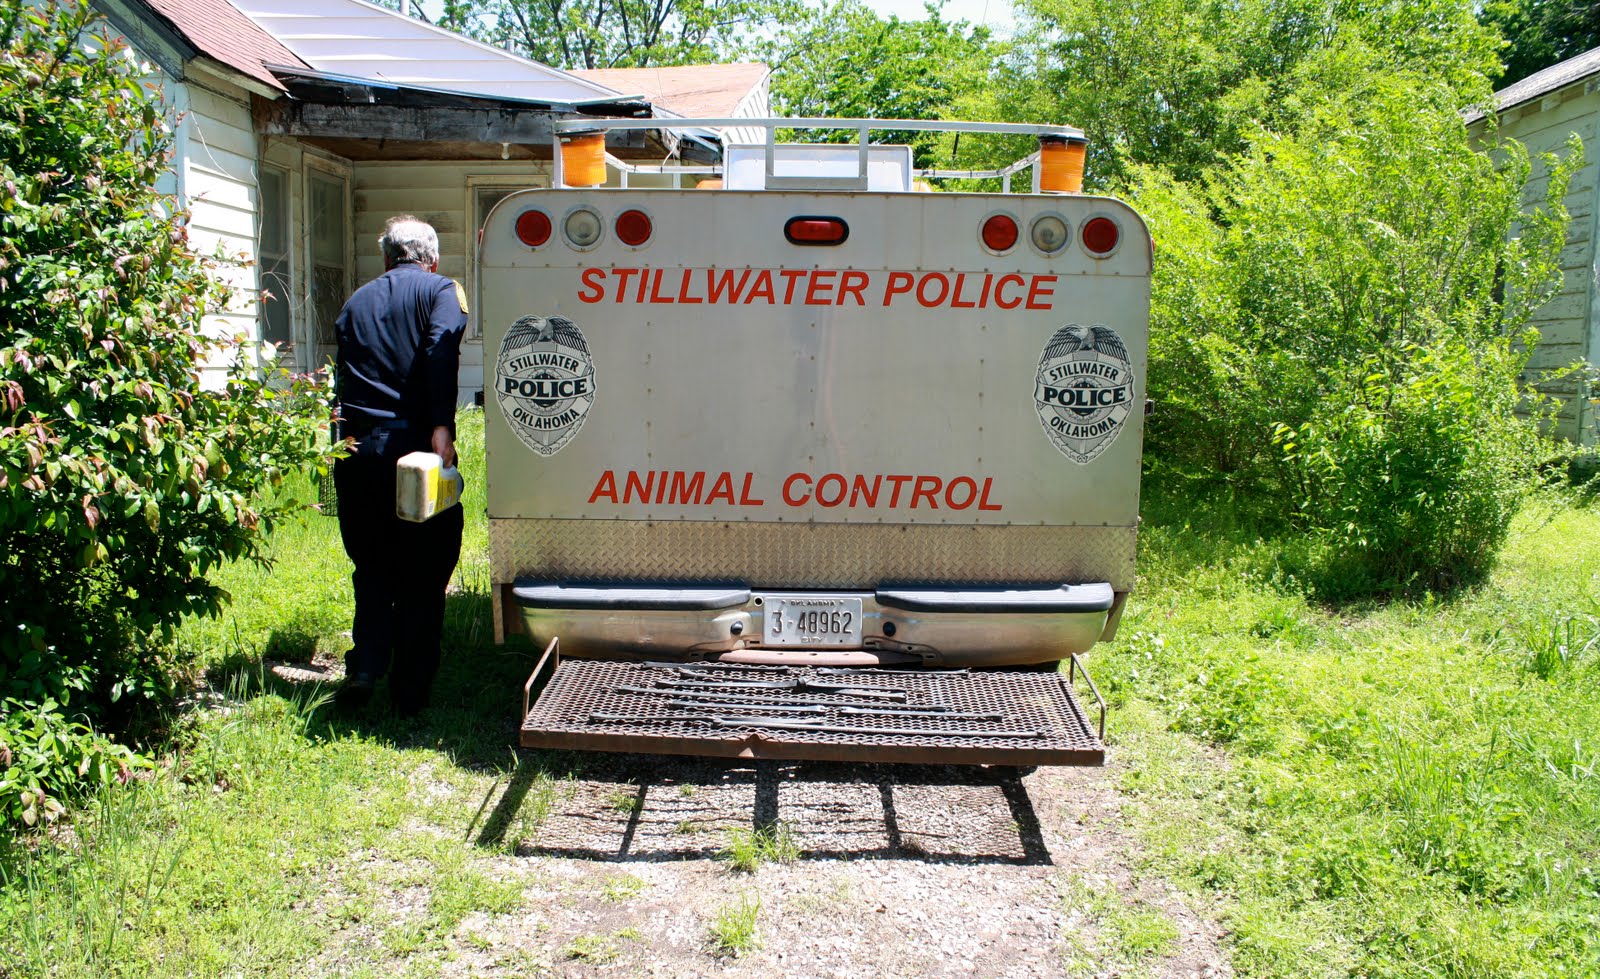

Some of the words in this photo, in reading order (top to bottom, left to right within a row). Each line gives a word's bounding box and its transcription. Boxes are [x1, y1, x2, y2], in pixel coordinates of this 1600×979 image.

[577, 268, 870, 306] STILLWATER
[882, 271, 1058, 310] POLICE
[509, 353, 580, 373] STILLWATER
[1049, 362, 1119, 381] STILLWATER
[504, 378, 588, 398] POLICE
[1043, 386, 1126, 407] POLICE
[512, 407, 580, 430] OKLAHOMA
[1050, 416, 1118, 438] OKLAHOMA
[588, 470, 764, 506] ANIMAL
[782, 472, 1003, 511] CONTROL
[790, 599, 836, 607] OKLAHOMA
